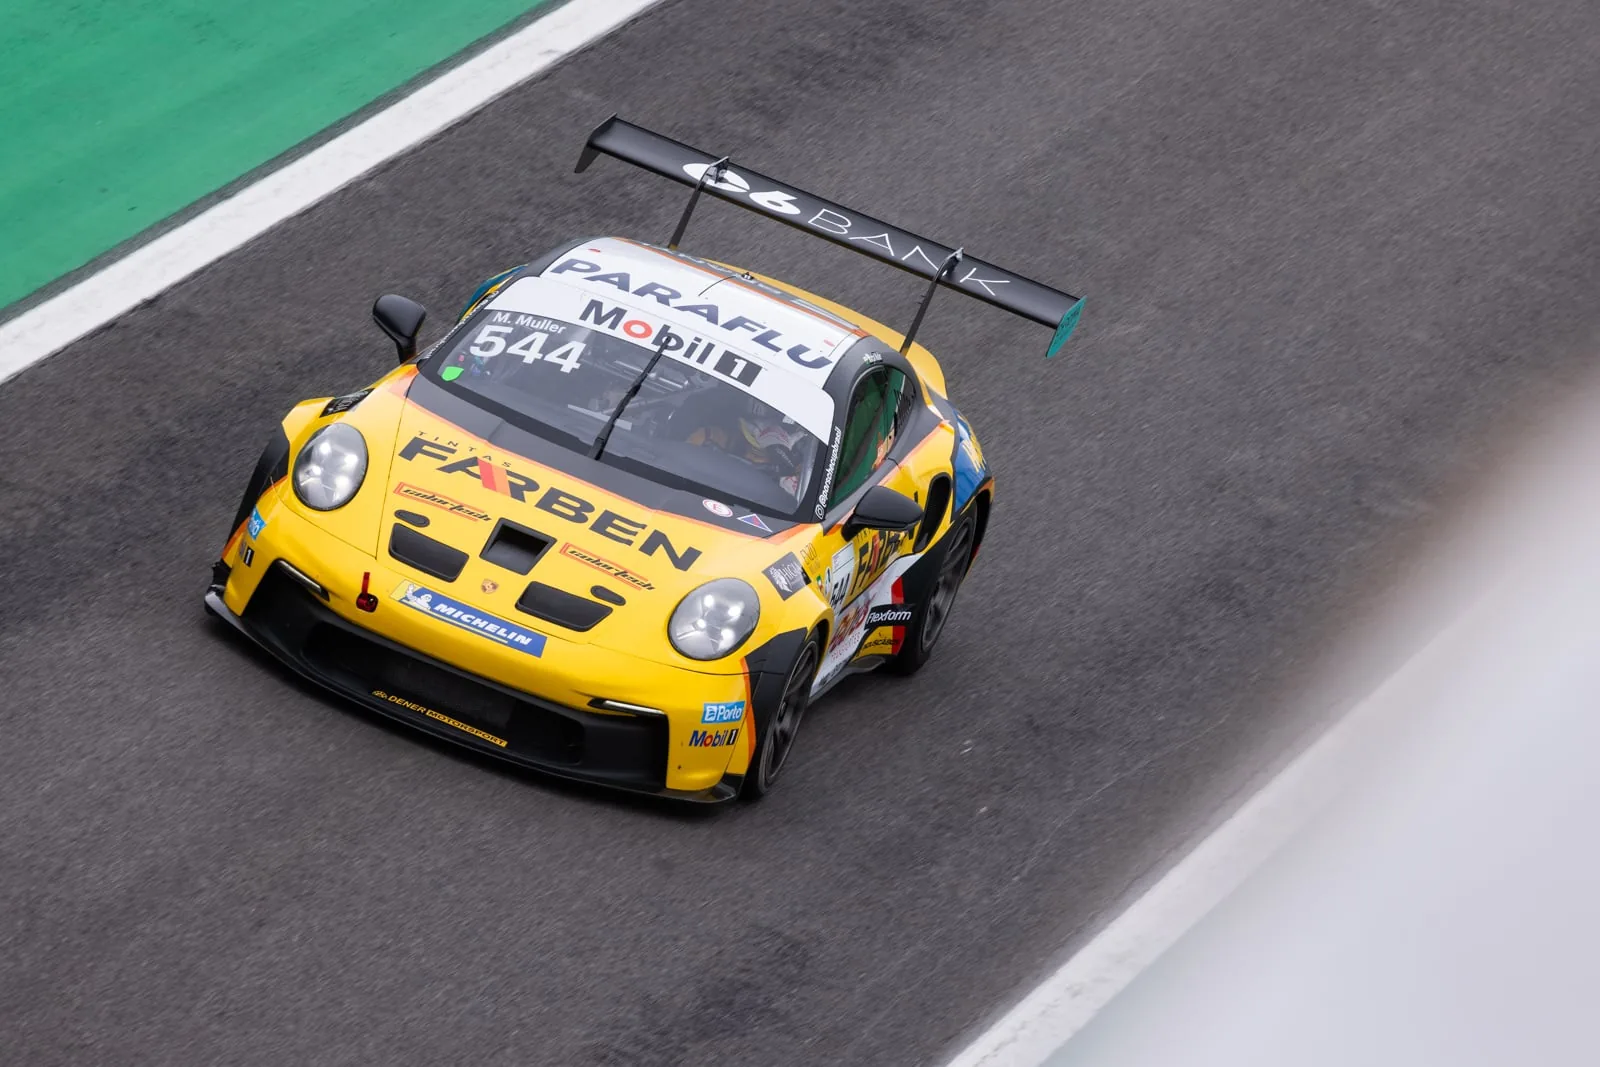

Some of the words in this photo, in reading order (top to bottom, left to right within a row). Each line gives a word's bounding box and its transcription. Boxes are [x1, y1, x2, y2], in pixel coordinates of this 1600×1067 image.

[808, 208, 1010, 296] BANK
[492, 311, 511, 324] M.
[515, 314, 567, 334] Muller
[551, 258, 832, 369] PARAFLU
[579, 298, 715, 366] Mobil
[469, 324, 587, 375] 544
[418, 430, 512, 468] TINTAS
[398, 436, 703, 572] FARBEN
[433, 603, 533, 646] MICHELIN
[387, 695, 427, 714] DENER
[427, 709, 507, 747] MOTORSPORT
[689, 729, 729, 747] Mobil
[716, 705, 743, 721] Porto
